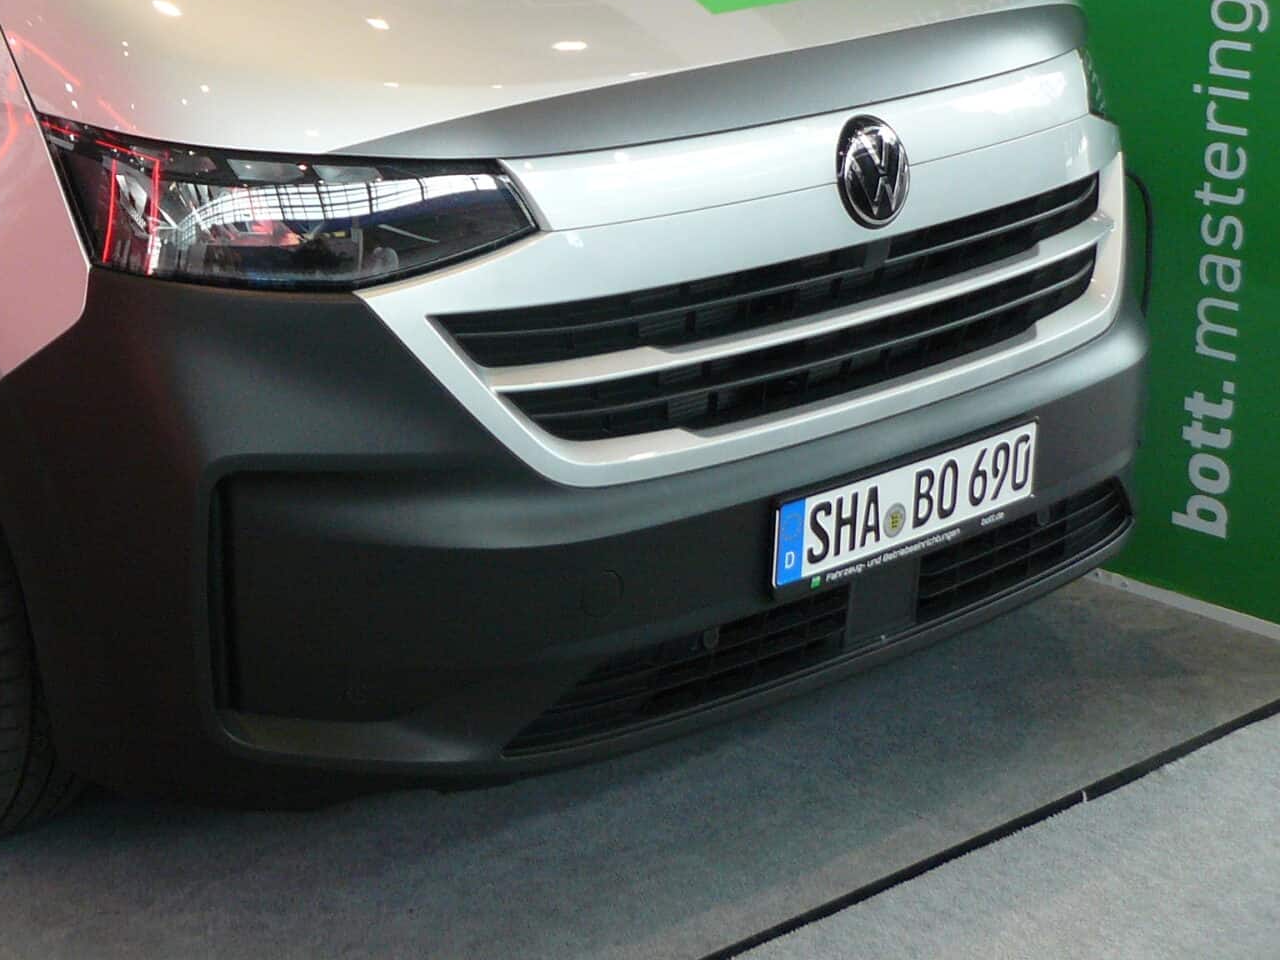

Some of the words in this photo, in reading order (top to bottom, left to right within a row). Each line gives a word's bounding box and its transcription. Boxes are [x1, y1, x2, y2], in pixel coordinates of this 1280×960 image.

[806, 485, 880, 565] SHA
[912, 458, 959, 529] BO
[969, 433, 1031, 507] 690
[1171, 380, 1236, 539] bott.
[784, 551, 795, 569] D
